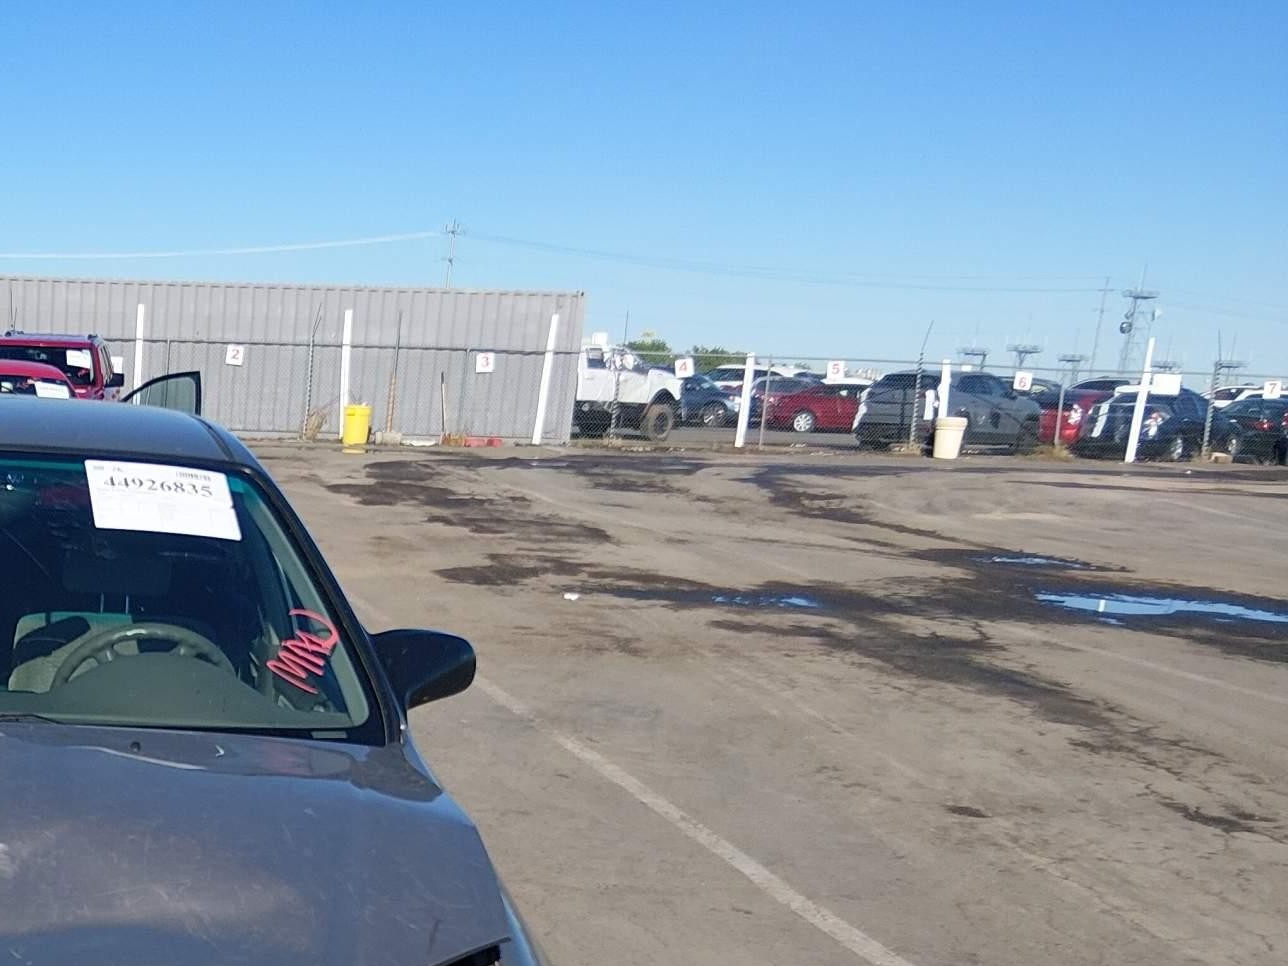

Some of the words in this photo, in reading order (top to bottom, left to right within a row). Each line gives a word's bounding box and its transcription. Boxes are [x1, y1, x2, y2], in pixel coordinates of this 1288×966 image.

[231, 349, 240, 360] 2
[481, 356, 489, 368] 3
[679, 360, 688, 372] 4
[831, 363, 840, 375] 5
[1018, 376, 1027, 388] 6
[1268, 382, 1277, 394] 7
[103, 475, 214, 498] 44926835
